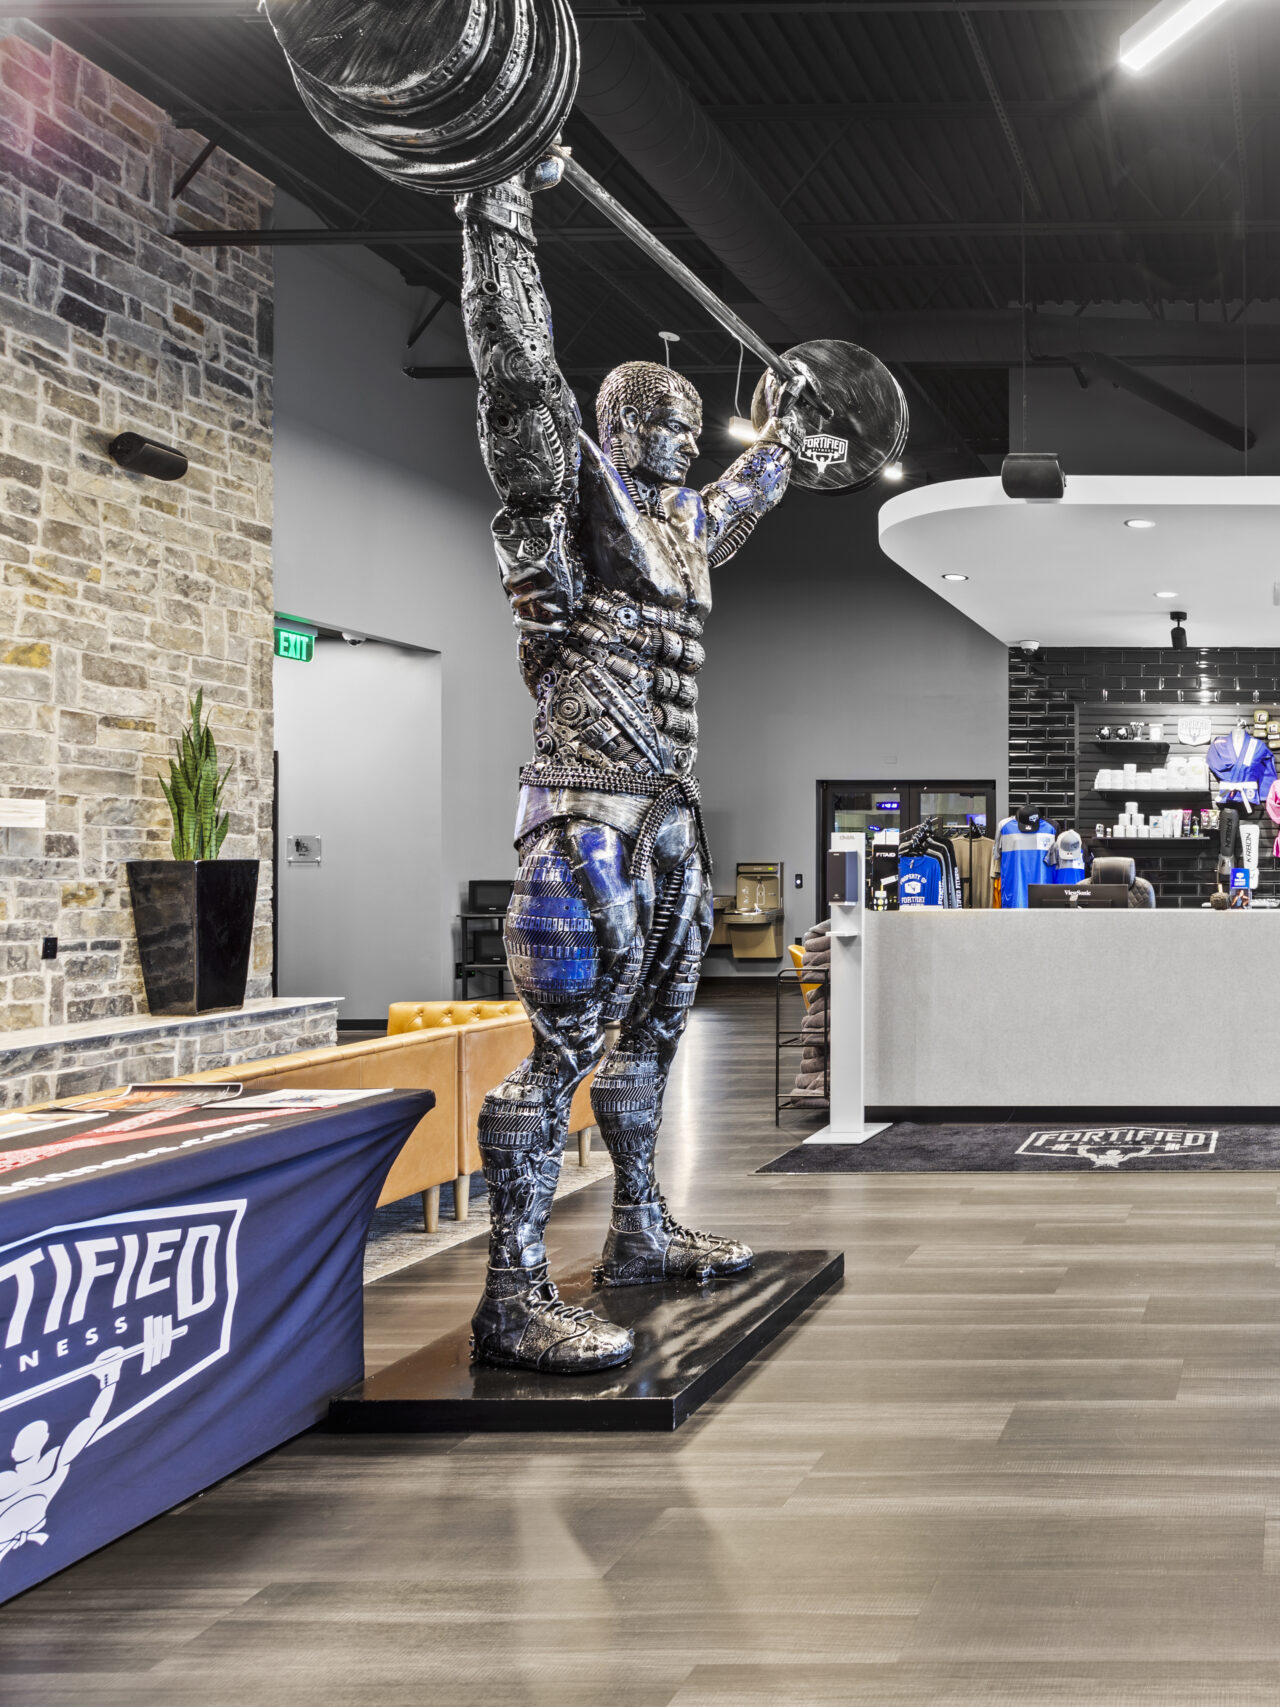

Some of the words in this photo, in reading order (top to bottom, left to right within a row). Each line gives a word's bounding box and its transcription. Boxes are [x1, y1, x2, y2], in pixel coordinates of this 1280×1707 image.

[803, 436, 846, 454] FORTIFIED
[279, 630, 309, 661] EXIT
[1033, 1129, 1205, 1146] FORTIFIED
[0, 1224, 221, 1349] TIFIED
[0, 1316, 128, 1372] NESS
